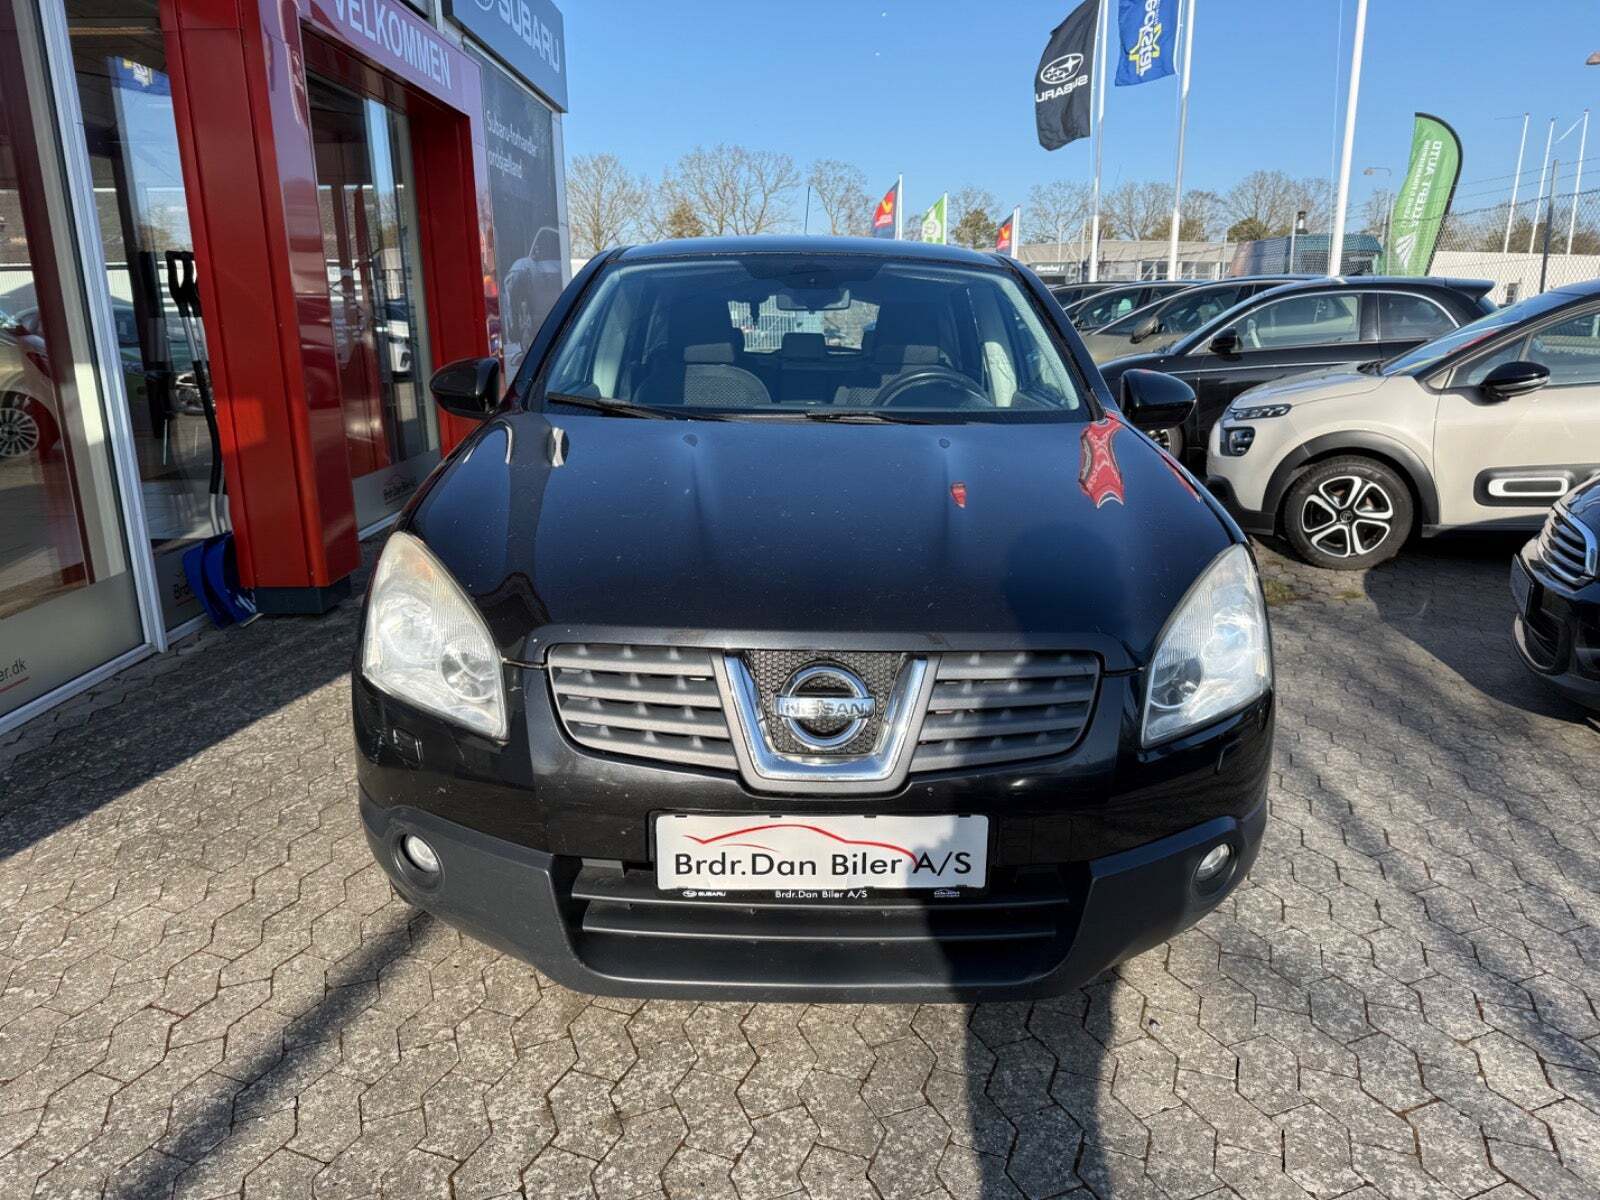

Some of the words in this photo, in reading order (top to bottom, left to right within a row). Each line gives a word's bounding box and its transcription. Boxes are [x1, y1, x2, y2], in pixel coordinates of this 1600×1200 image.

[498, 0, 560, 73] SUBARU
[786, 702, 865, 715] NSSAN
[675, 852, 816, 876] Brdr.Dan
[832, 852, 903, 876] Biler
[912, 851, 972, 876] A/S
[775, 890, 818, 899] Brdr.Dan
[822, 890, 844, 899] Biler
[848, 890, 867, 899] A/S
